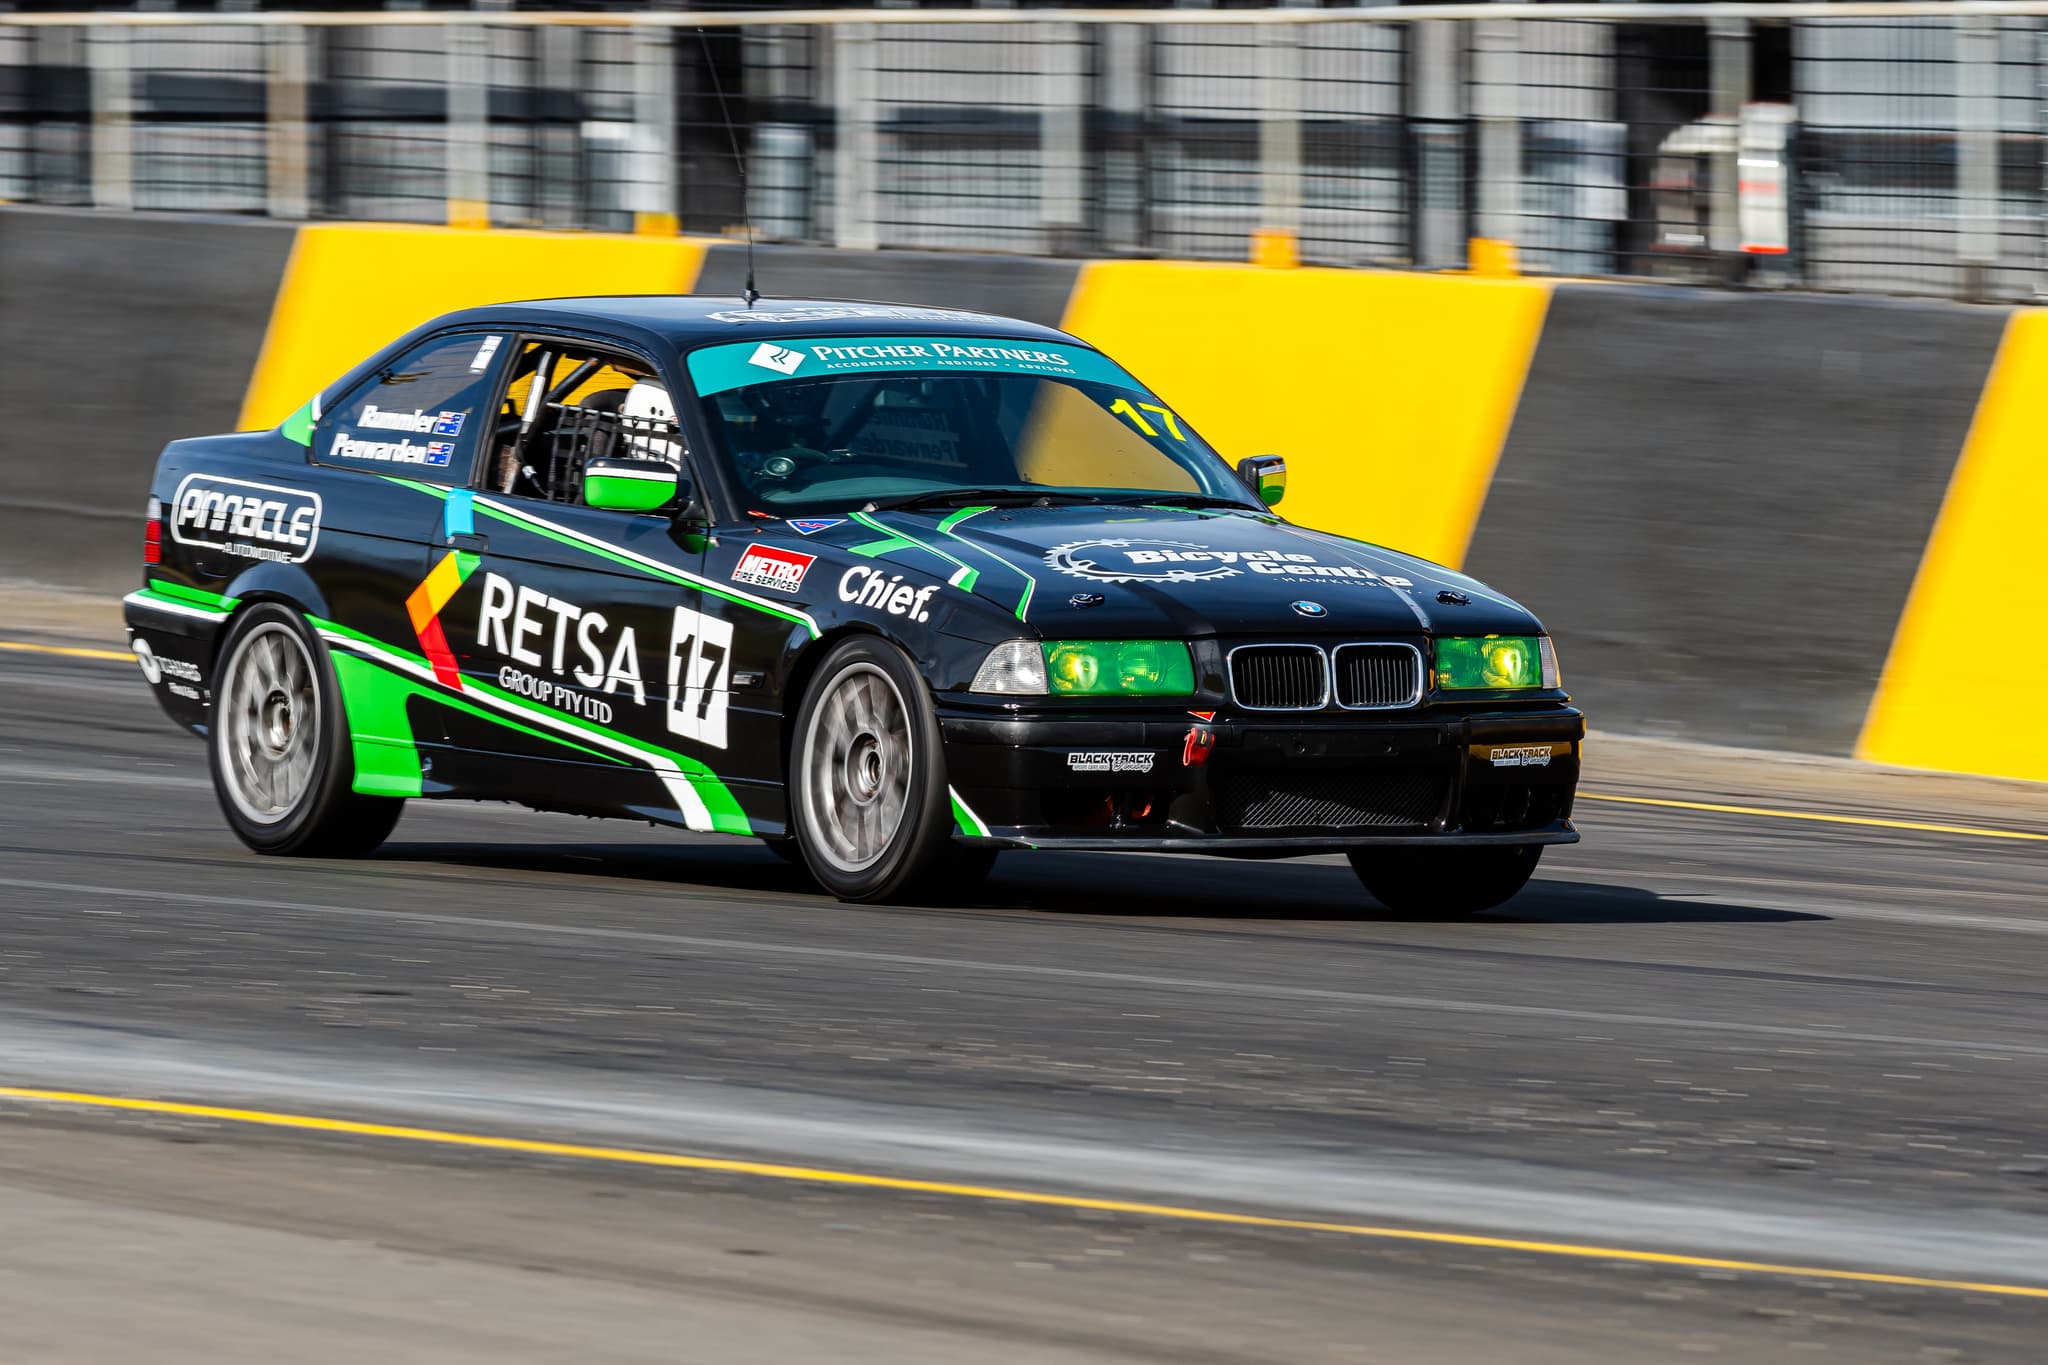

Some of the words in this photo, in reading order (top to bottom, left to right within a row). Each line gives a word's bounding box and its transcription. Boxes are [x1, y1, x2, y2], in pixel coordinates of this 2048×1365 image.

[810, 345, 932, 361] PITCHER
[929, 343, 1070, 366] PARTNERS
[827, 360, 916, 369] ACCOUNTANTS
[1018, 363, 1077, 374] ADVISORS
[1109, 398, 1188, 442] 17
[741, 554, 804, 582] METRO
[1122, 549, 1319, 565] Bicycle
[734, 570, 755, 583] FIRE
[754, 575, 799, 592] SERVICES
[1249, 560, 1414, 587] Centre
[838, 565, 941, 623] Chief.
[477, 572, 647, 706] RETSA
[674, 633, 727, 720] 17
[499, 665, 552, 701] GROUP
[554, 685, 584, 713] PTY
[584, 699, 613, 724] LTD
[1068, 753, 1111, 764] BLACK
[1112, 753, 1154, 765] TRACK
[1491, 748, 1521, 761] BLACK
[1522, 746, 1551, 759] TRACK
